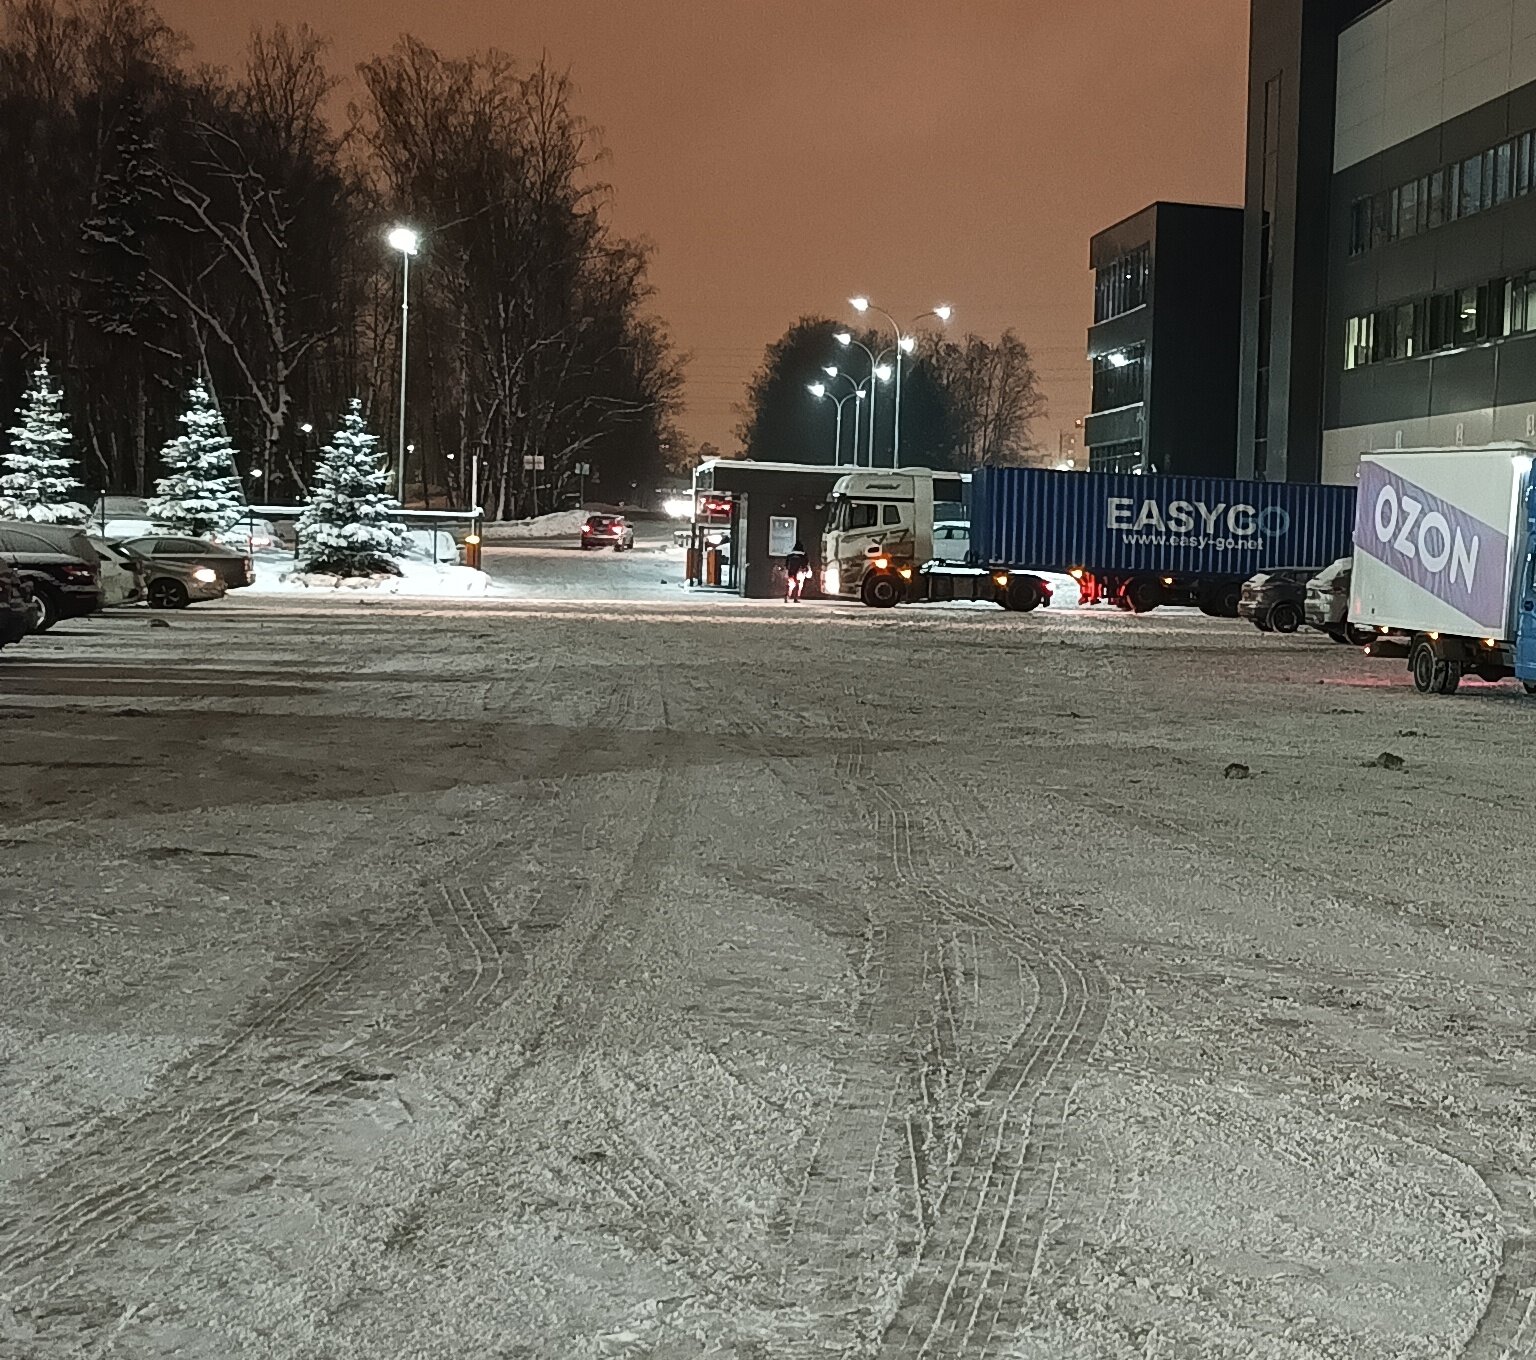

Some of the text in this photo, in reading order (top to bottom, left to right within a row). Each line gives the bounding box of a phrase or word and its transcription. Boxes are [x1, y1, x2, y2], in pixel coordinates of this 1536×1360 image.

[1107, 497, 1290, 537] EASYGO
[1122, 532, 1263, 551] www.easy-go.net
[1375, 484, 1479, 594] OZON
